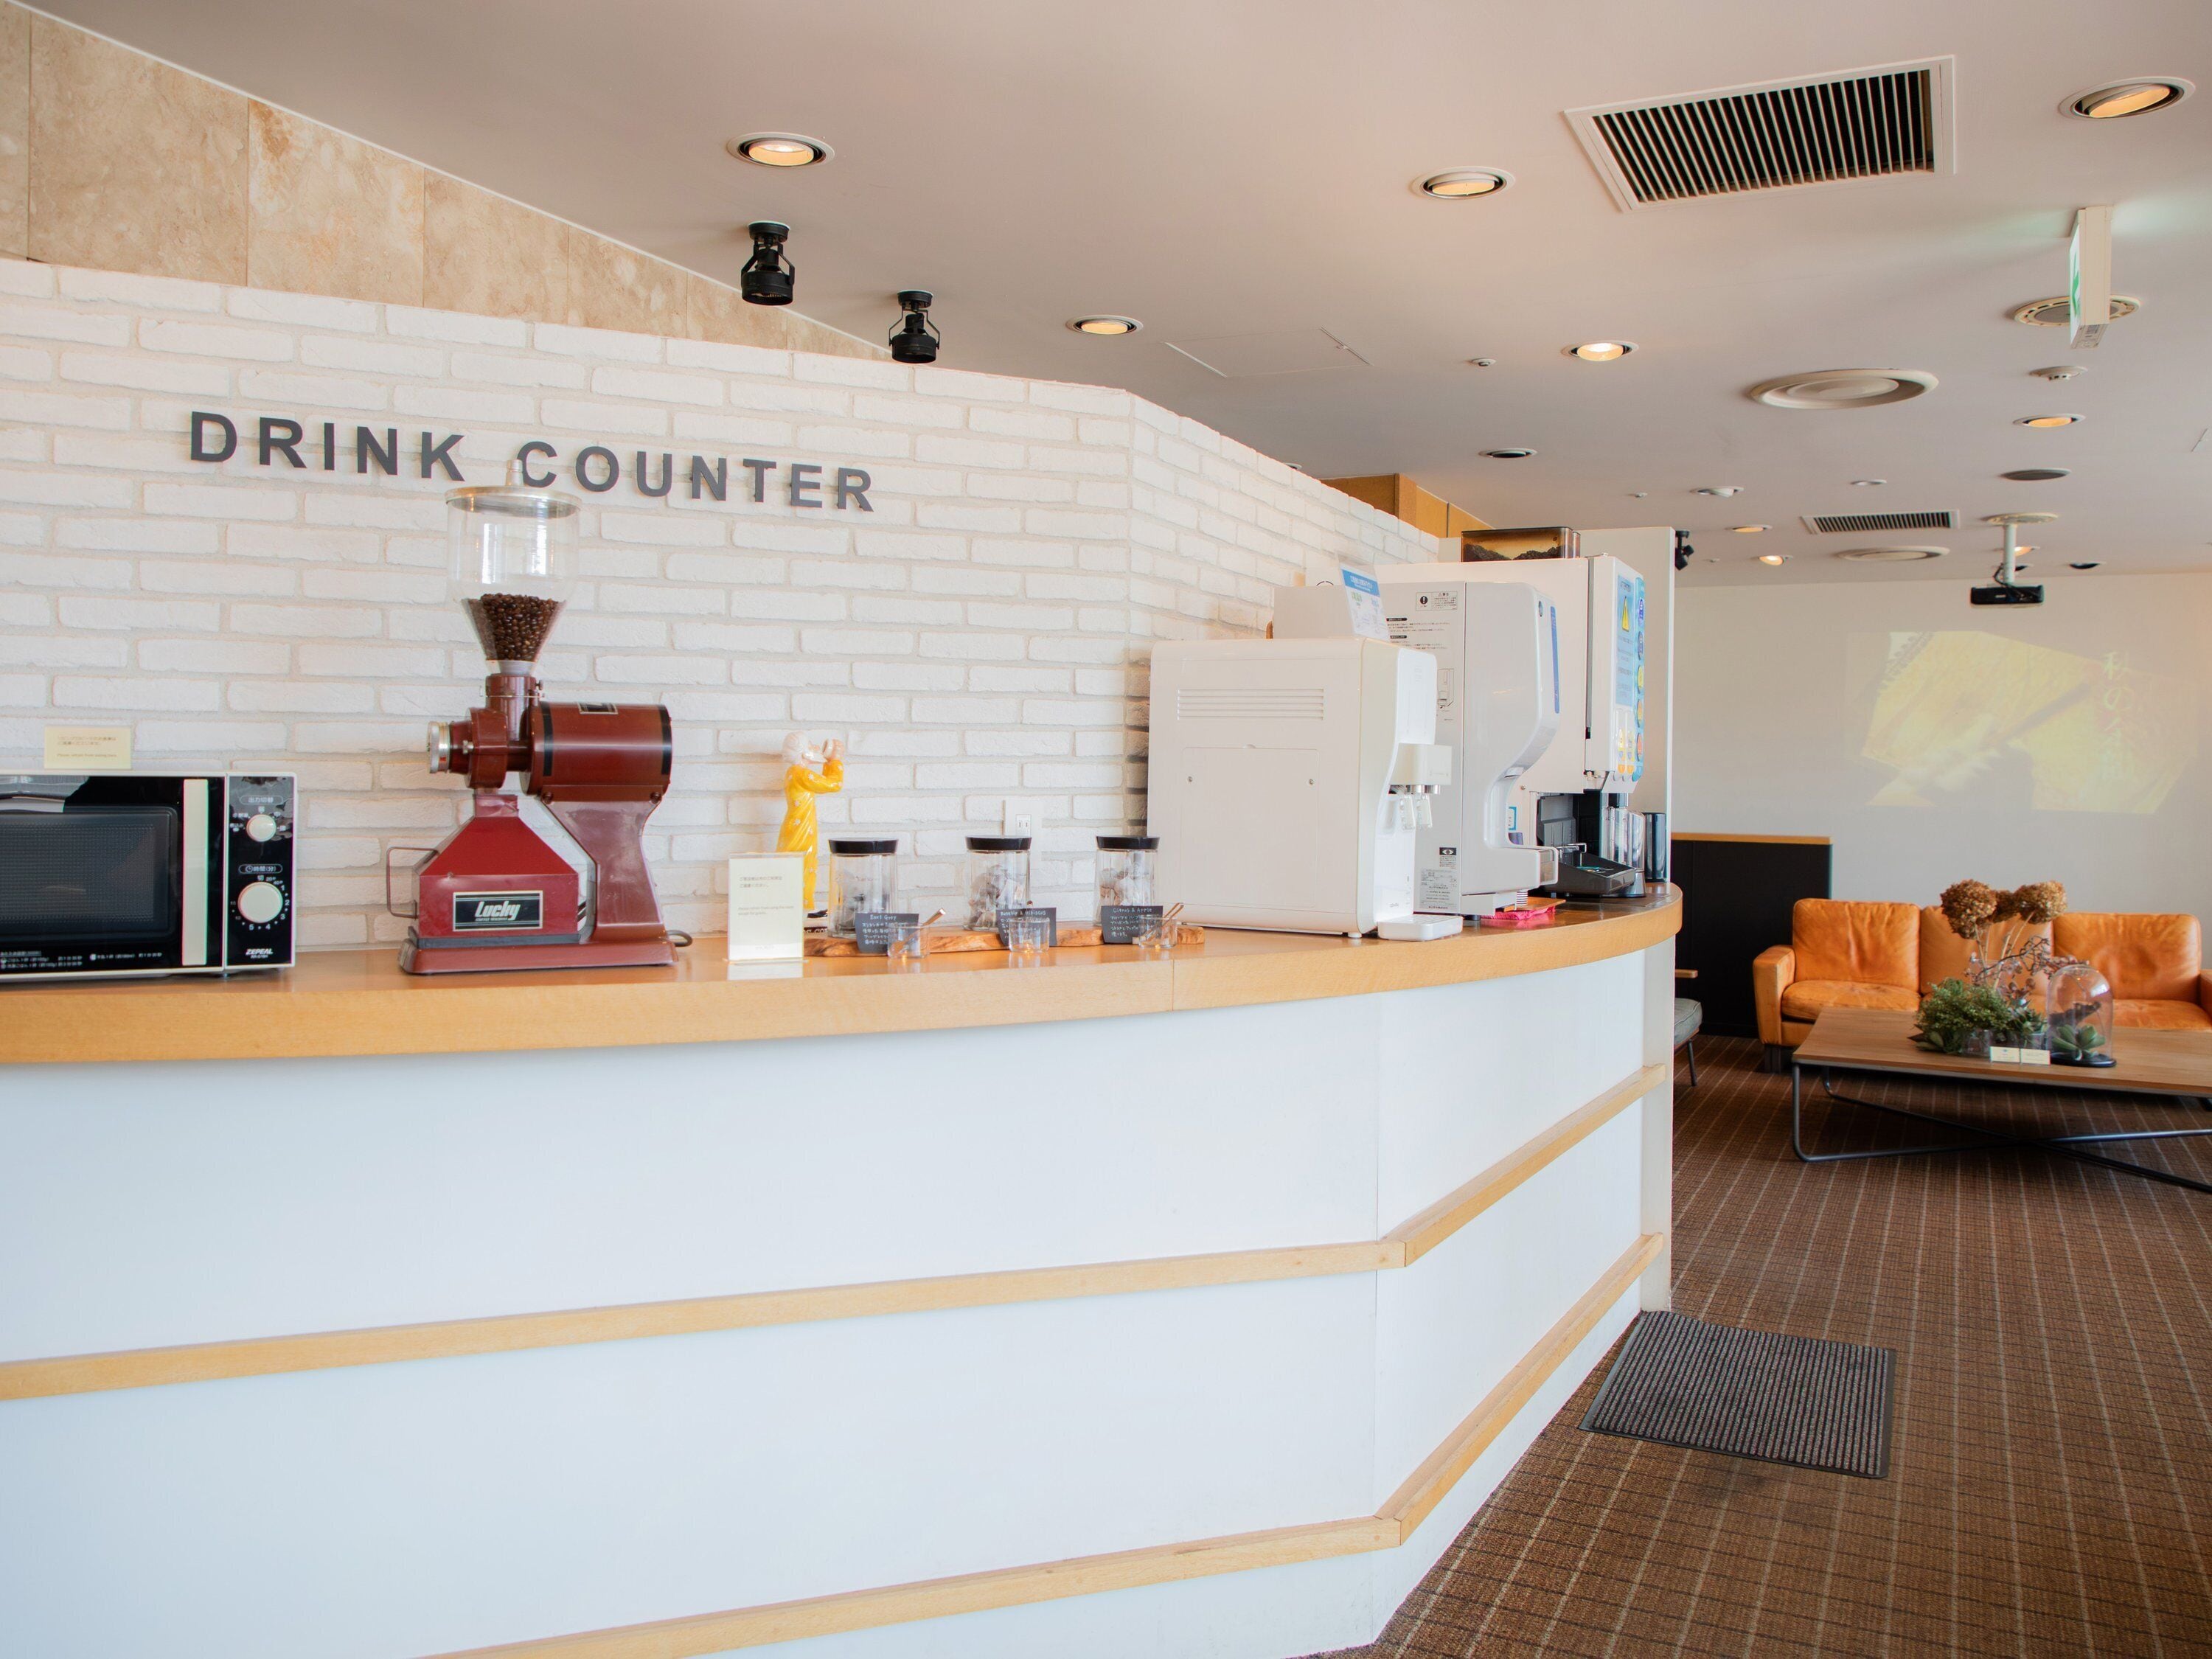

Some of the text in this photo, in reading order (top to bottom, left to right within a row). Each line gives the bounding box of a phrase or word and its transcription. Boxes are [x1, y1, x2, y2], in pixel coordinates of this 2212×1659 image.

[191, 411, 874, 512] DRINK COUNTER
[474, 900, 521, 921] Lucky
